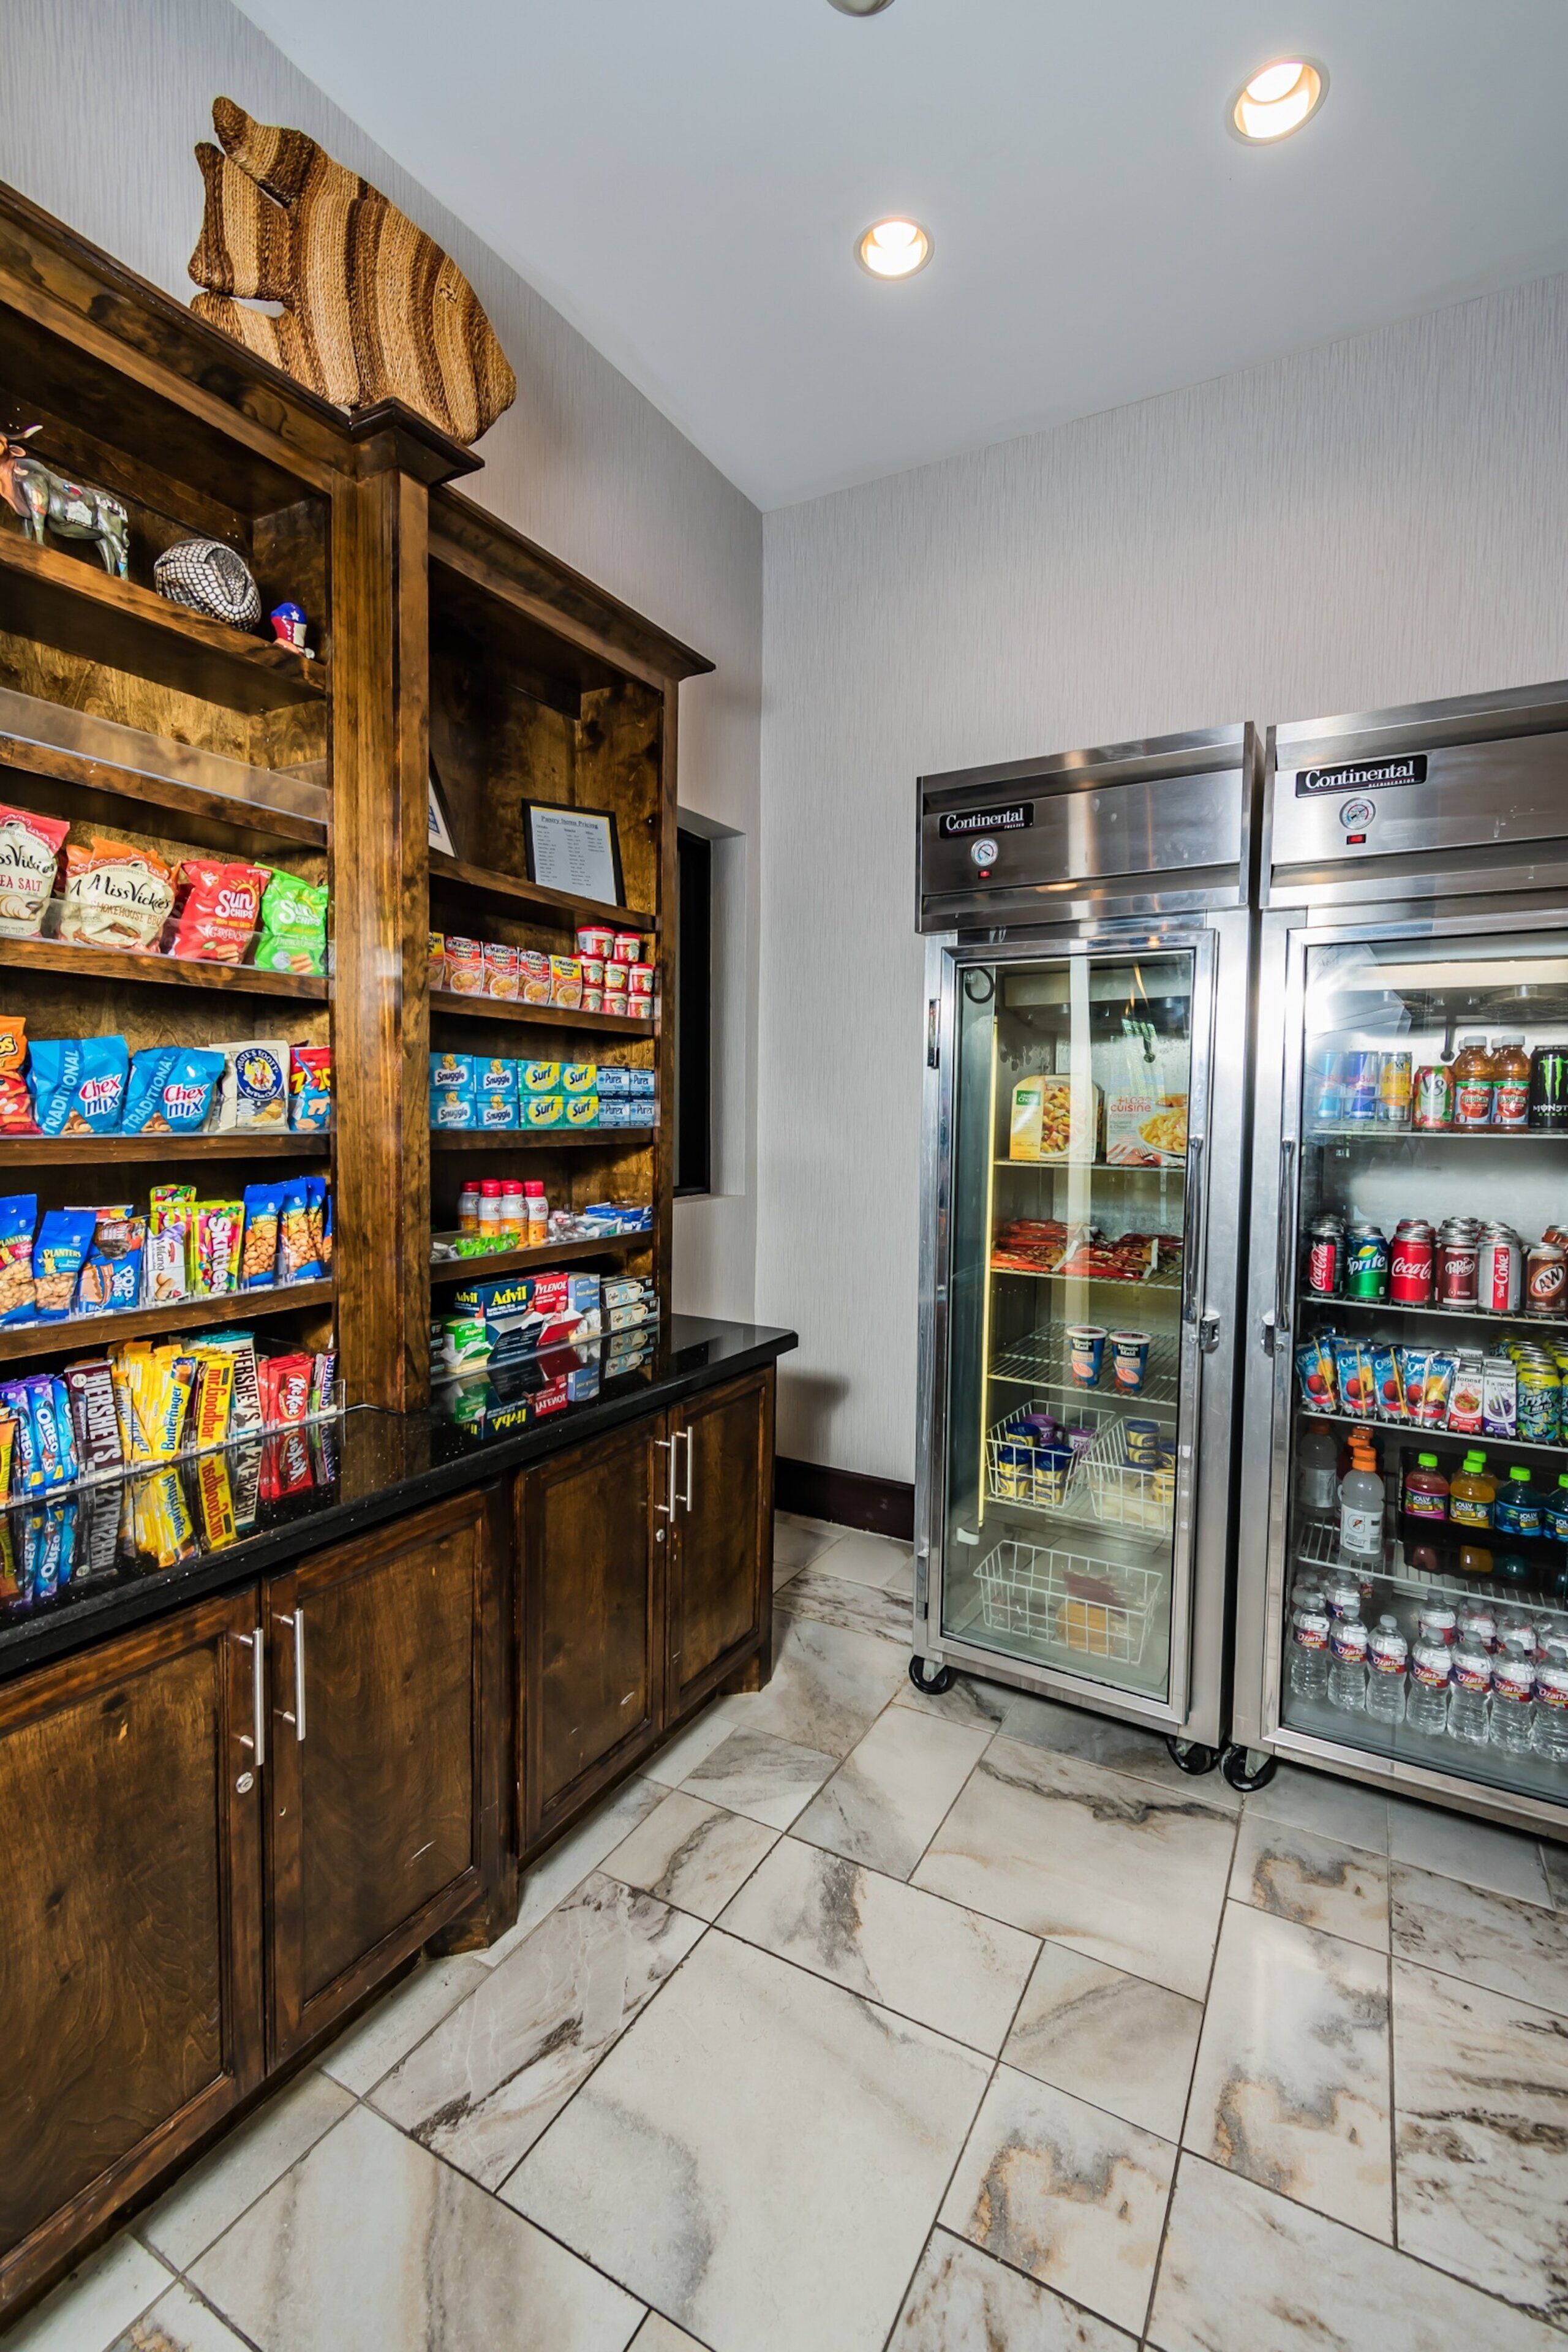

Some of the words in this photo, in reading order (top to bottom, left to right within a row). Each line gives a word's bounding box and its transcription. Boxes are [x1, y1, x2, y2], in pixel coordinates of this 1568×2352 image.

[1305, 761, 1415, 789] Continental
[540, 815, 560, 824] Pantry
[578, 821, 598, 830] Pricing
[946, 808, 1024, 831] Continental
[0, 875, 13, 891] EA
[18, 878, 42, 892] SALT
[127, 880, 171, 914] Vickie's
[214, 889, 255, 918] Sun
[230, 909, 254, 919] CHIPS
[437, 1071, 465, 1082] Snuggle
[486, 1074, 510, 1086] Snuggle
[532, 1064, 552, 1083] Surf
[569, 1066, 589, 1085] Surf
[605, 1072, 622, 1084] Purex
[633, 1074, 649, 1085] Purex
[42, 1050, 79, 1134] TRADITIONAL
[80, 1075, 121, 1101] Chex
[122, 1055, 175, 1129] TRADITIONAL
[164, 1084, 208, 1102] Chex
[440, 1107, 468, 1120] Snuggle
[486, 1109, 511, 1121] Snuggle
[535, 1098, 556, 1117] Surf
[572, 1098, 591, 1117] Surf
[605, 1103, 624, 1115] Purex
[636, 1103, 653, 1115] Purex
[1110, 1104, 1152, 1114] cuisine
[1532, 1103, 1568, 1112] MONST
[43, 1248, 81, 1259] PLANTERS
[156, 1239, 165, 1271] Milano
[208, 1216, 232, 1294] Skittles
[1348, 1254, 1385, 1275] Sprite
[1494, 1254, 1509, 1284] Coke
[454, 1292, 478, 1303] Advil
[491, 1286, 527, 1306] Advil
[535, 1281, 567, 1296] TYLENOL
[1432, 1363, 1452, 1373] SUN
[232, 1348, 261, 1423] HERSHEY'S
[321, 1356, 336, 1407] SNICKERS
[1518, 1391, 1553, 1408] Brisk
[84, 1373, 123, 1463] HERSHEY'S
[160, 1385, 183, 1450] Butterfinger
[202, 1388, 227, 1439] Goodbar
[36, 1408, 59, 1452] OREO
